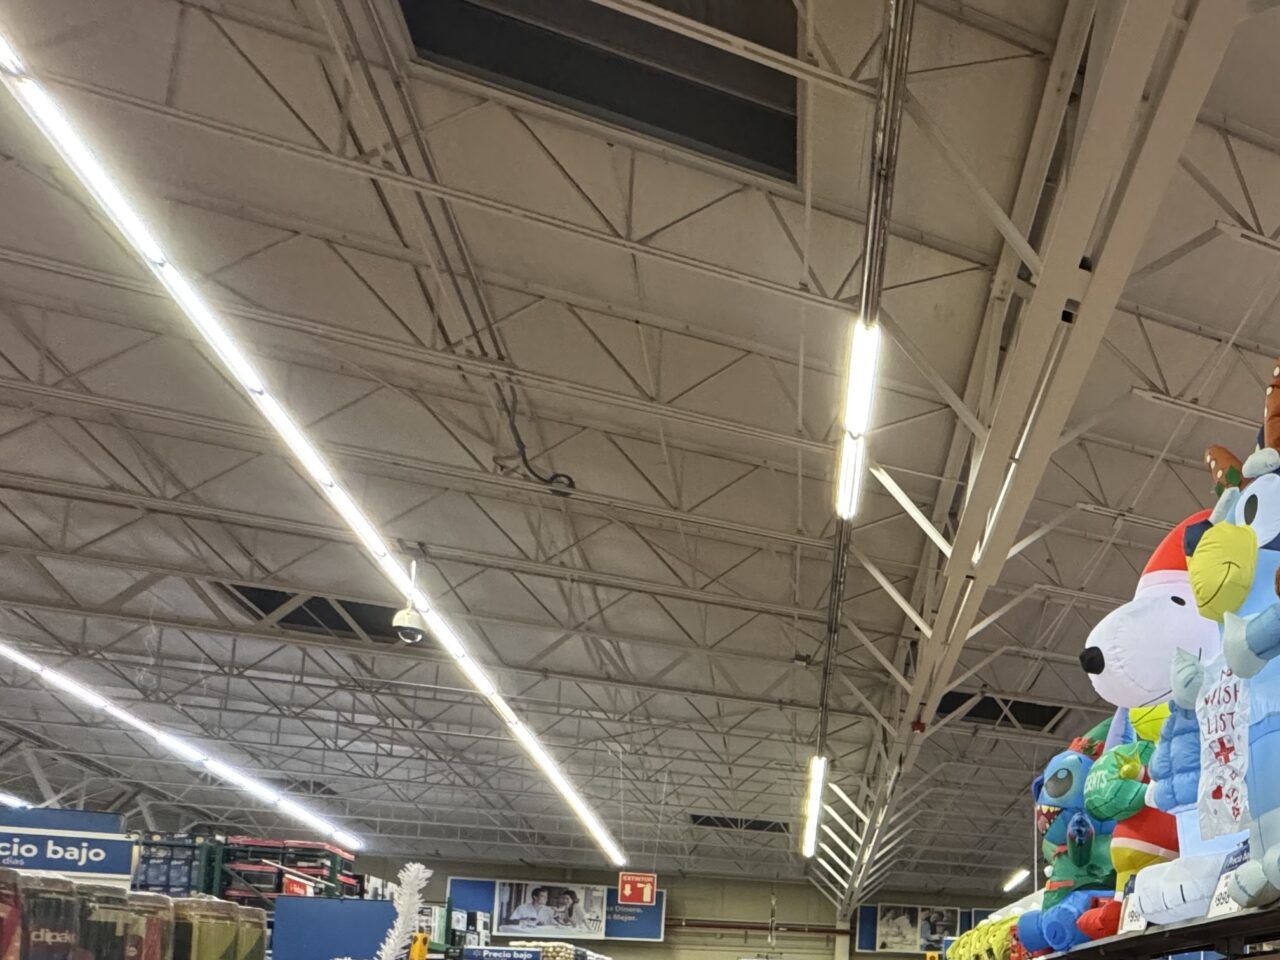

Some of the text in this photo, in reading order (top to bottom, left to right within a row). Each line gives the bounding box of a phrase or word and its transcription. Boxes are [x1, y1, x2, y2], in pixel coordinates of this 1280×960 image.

[1207, 711, 1236, 735] LIST
[46, 840, 106, 866] bajo
[483, 950, 511, 959] Precio
[513, 951, 533, 960] bajo
